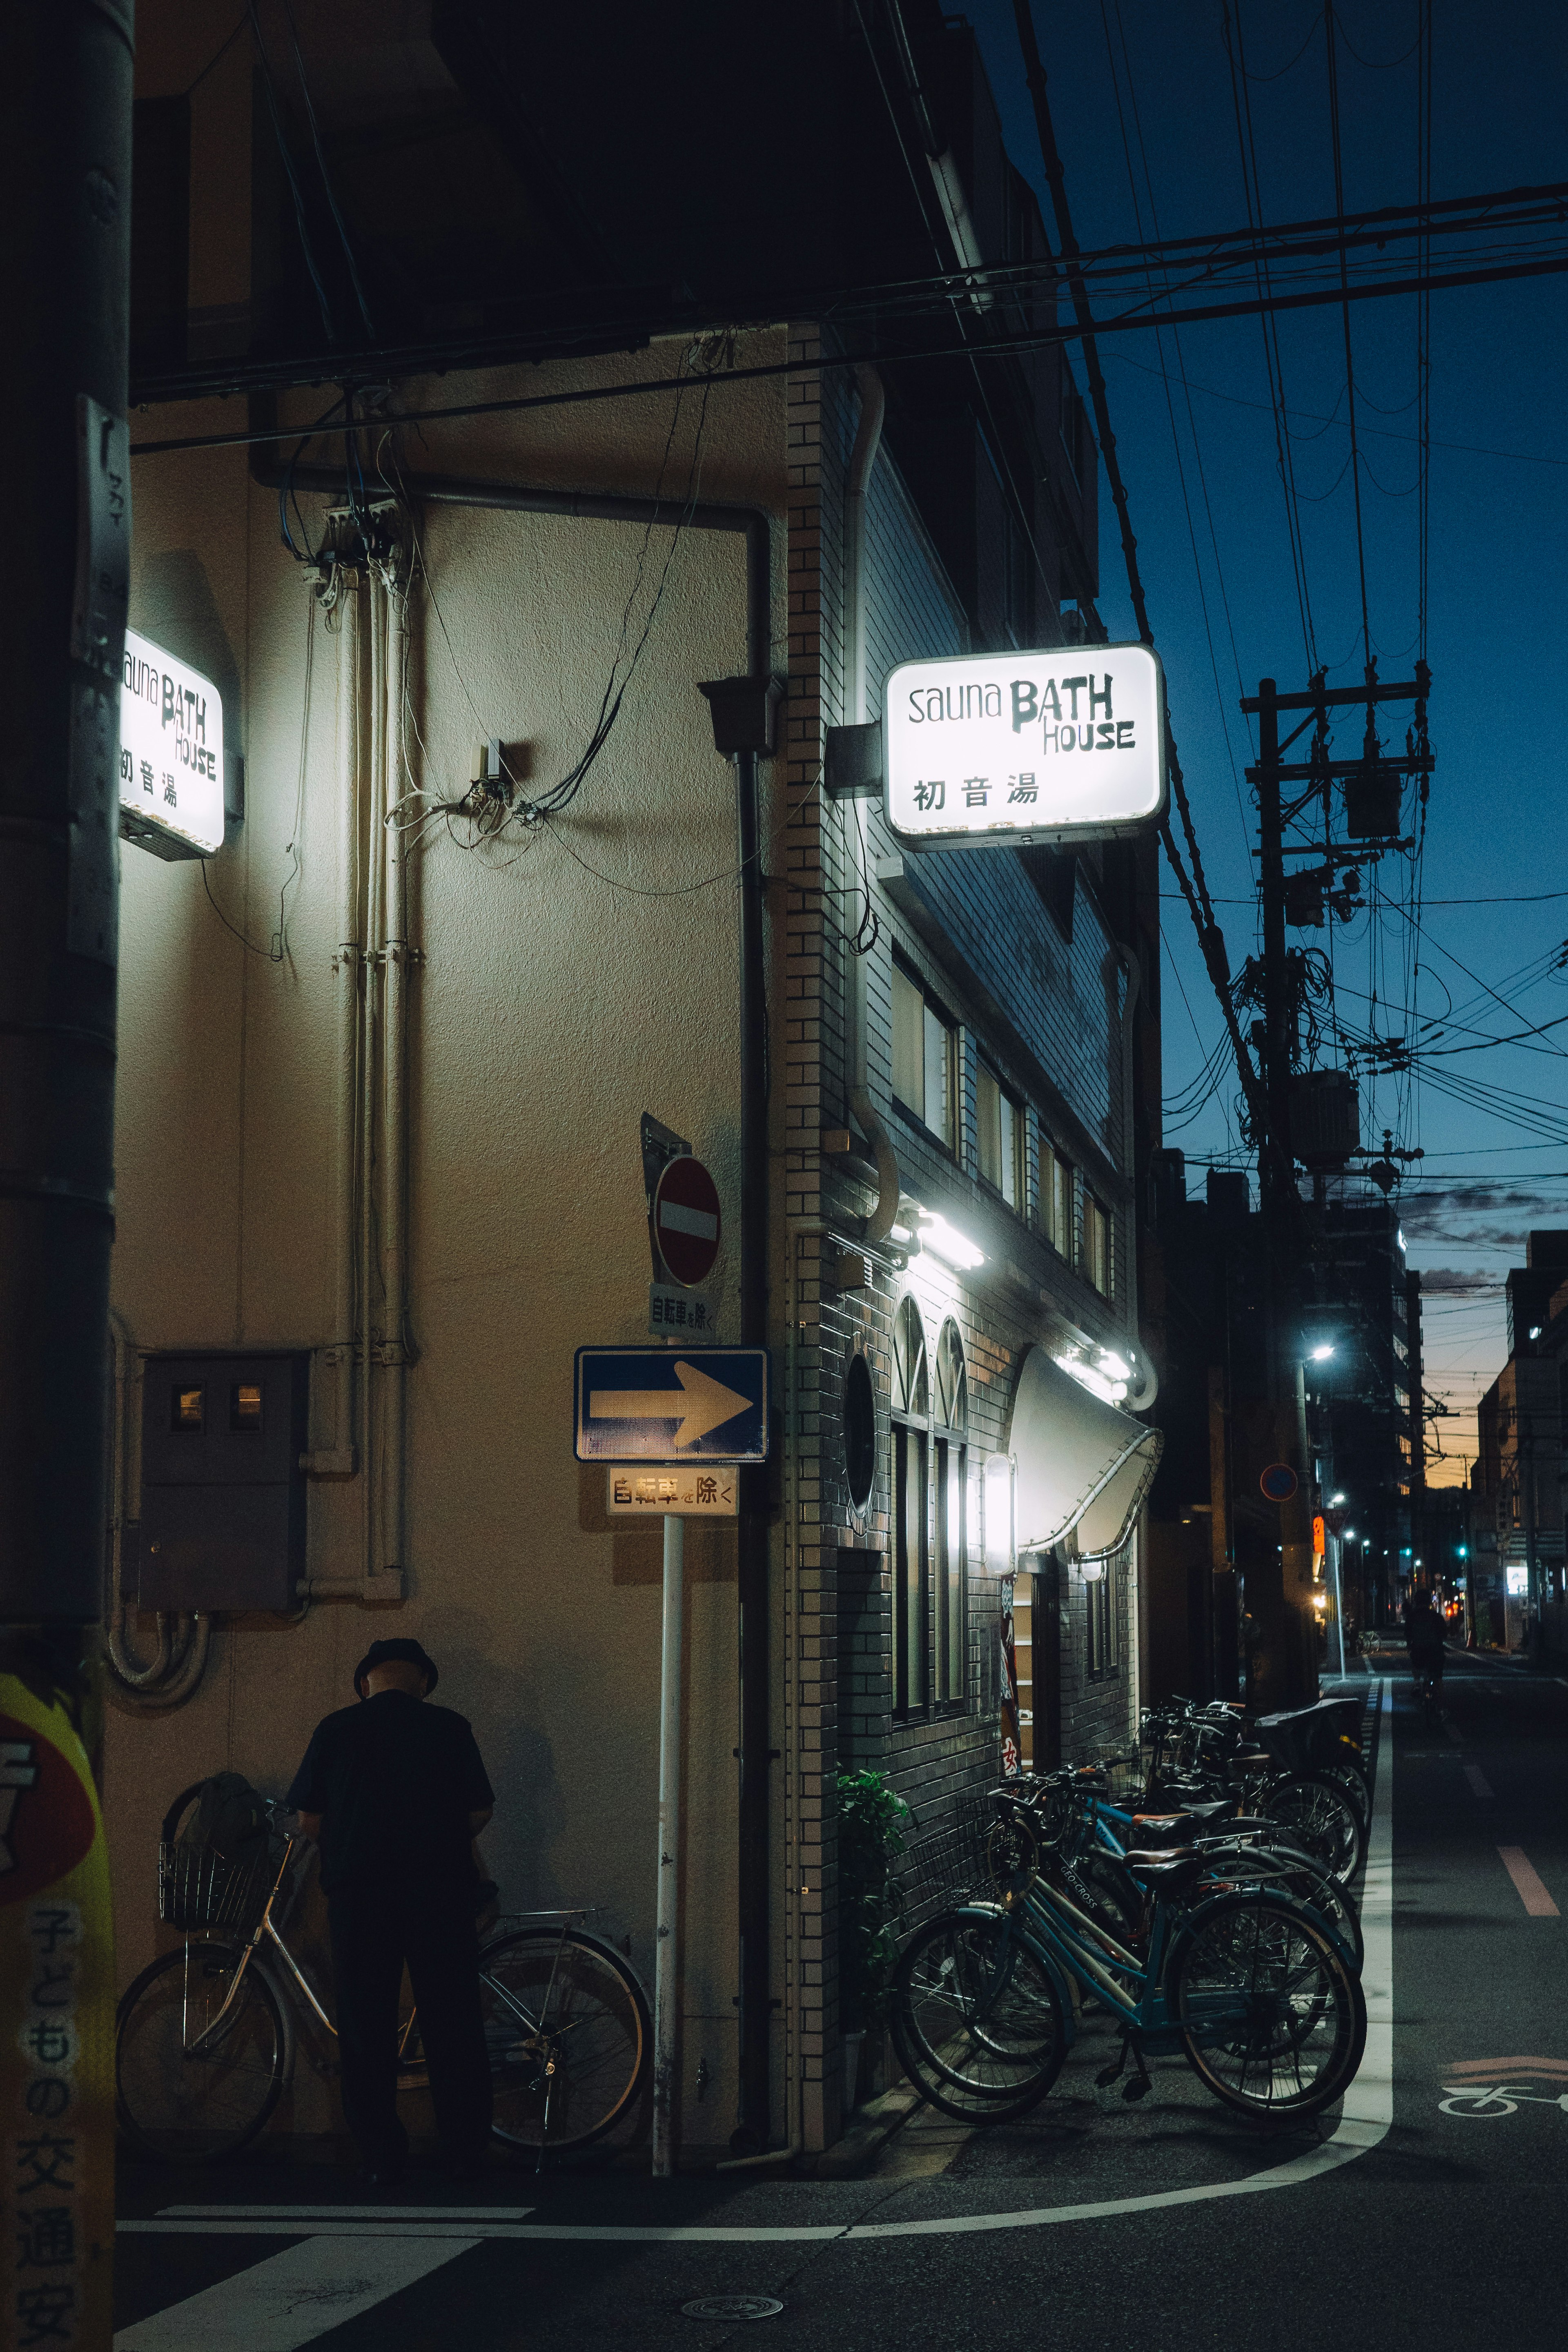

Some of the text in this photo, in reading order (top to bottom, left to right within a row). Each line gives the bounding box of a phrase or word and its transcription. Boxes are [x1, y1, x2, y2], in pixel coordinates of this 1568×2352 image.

[124, 650, 206, 745] auna BATH
[908, 672, 1114, 734] sauna BATH
[176, 719, 216, 782] HOUSE
[1043, 715, 1136, 755] HOUSE
[912, 772, 1040, 811] 初音湯
[653, 1295, 713, 1332] 自転車を除く
[614, 1476, 732, 1504] 自転車を除く
